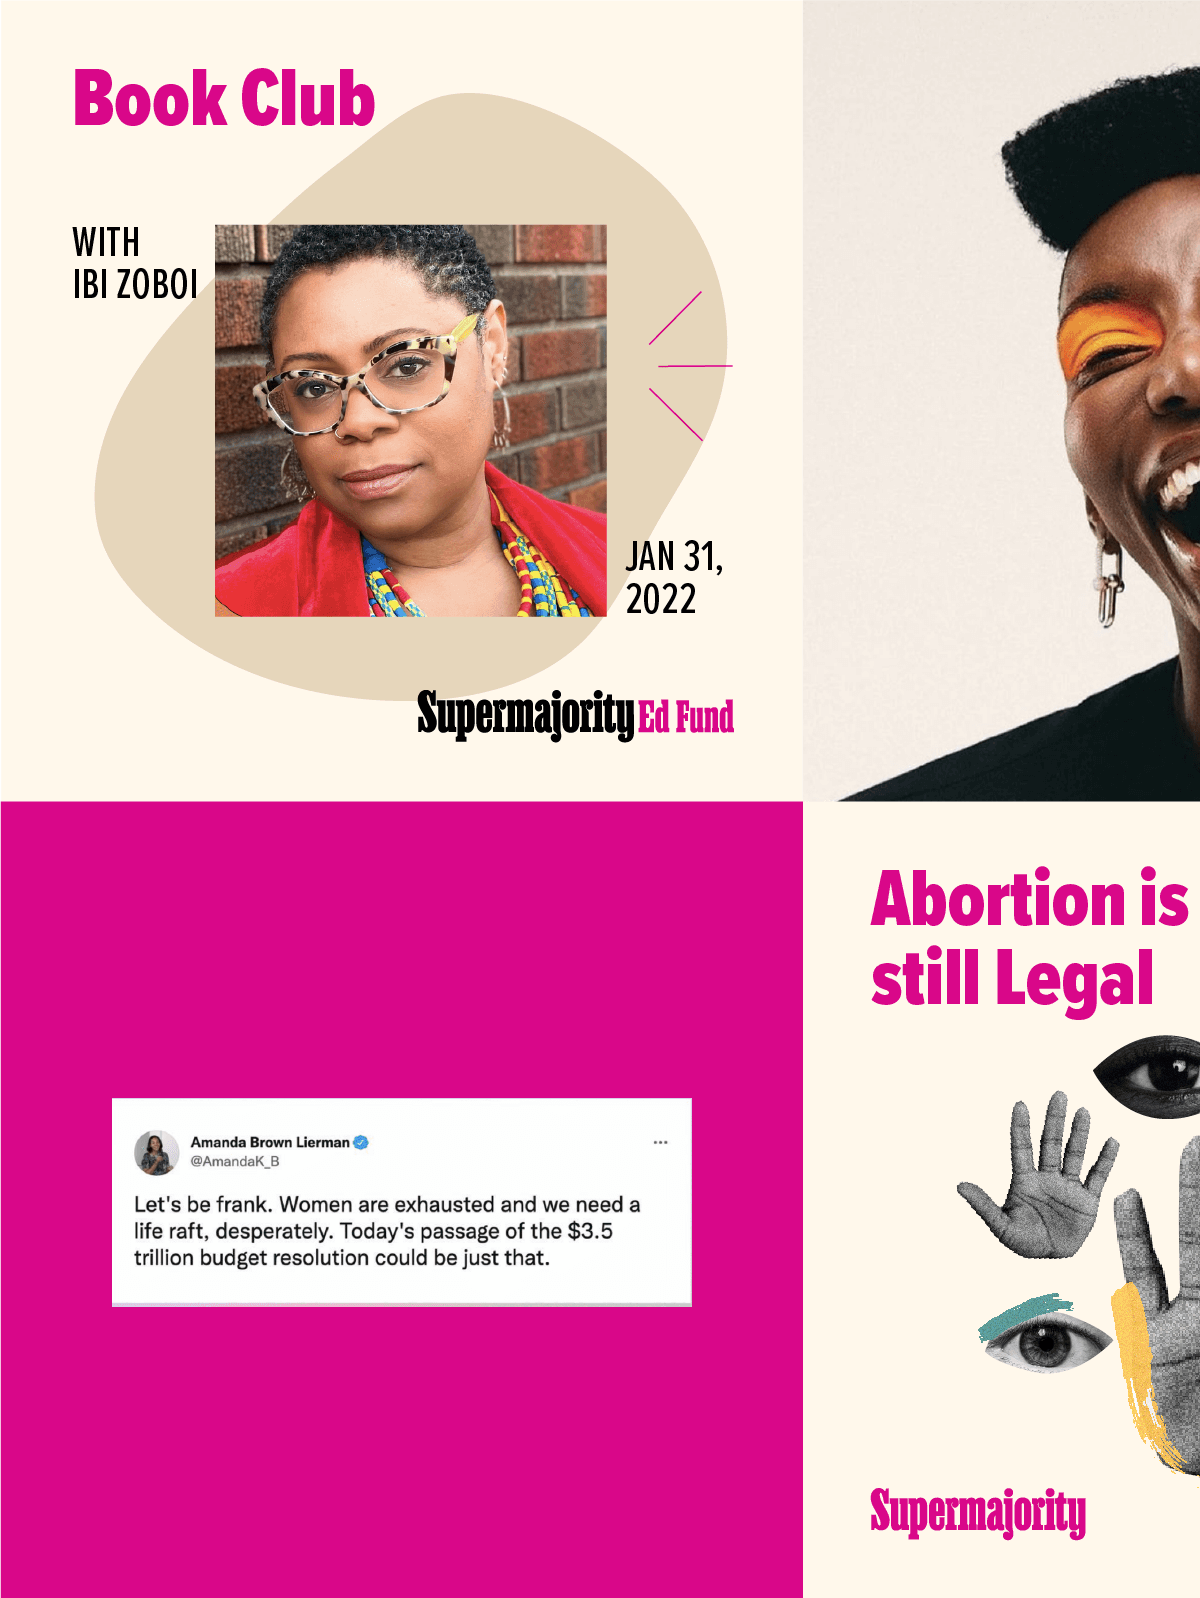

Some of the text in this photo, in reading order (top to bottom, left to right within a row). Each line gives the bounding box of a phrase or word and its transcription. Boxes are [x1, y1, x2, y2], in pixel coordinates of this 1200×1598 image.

[75, 68, 375, 126] Book Club
[72, 227, 138, 257] WITH
[74, 268, 197, 299] IBI ZOBOI
[625, 540, 723, 575] JAN 31,
[626, 583, 696, 614] 2022
[417, 690, 735, 743] Supermajority Ed Fund
[870, 866, 1189, 927] Abortion is
[871, 945, 1153, 1020] still Legal
[190, 1136, 350, 1148] Amanda Brown Lierman
[190, 1155, 280, 1170] @AmandaK_B
[135, 1195, 641, 1213] Let's be frank. Women are exhausted and we need a
[135, 1221, 613, 1244] life raft, desperately. Today's passage of the $3.5
[134, 1248, 550, 1271] trillion budget resolution could be just that.
[871, 1488, 1087, 1540] Supermajority
